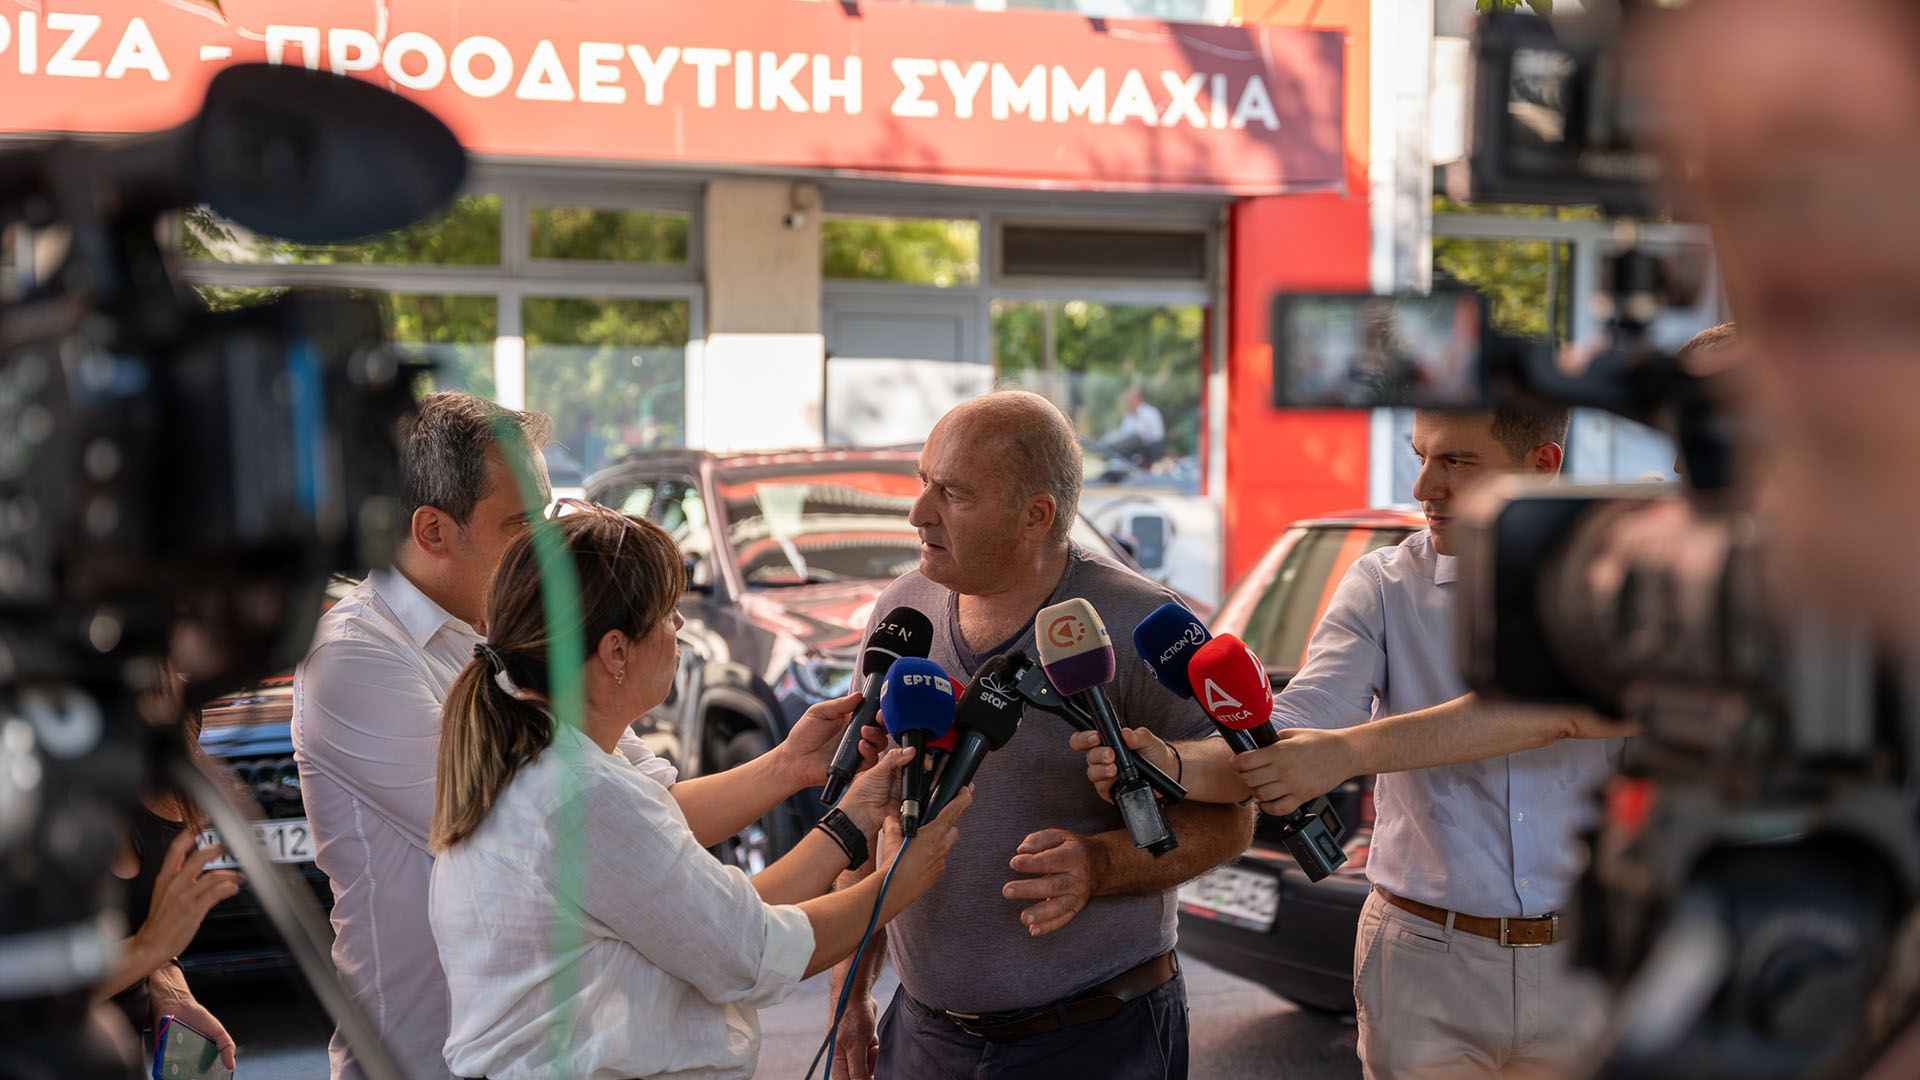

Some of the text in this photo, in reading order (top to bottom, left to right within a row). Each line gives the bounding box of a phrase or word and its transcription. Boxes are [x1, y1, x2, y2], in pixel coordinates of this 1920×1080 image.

[0, 11, 171, 81] ΙΖΑ
[265, 25, 862, 115] ΠΡΟΟΔΕΥΤΙΚΗ
[891, 58, 1280, 131] ΣΥΜΜΑΧΙΑ
[1160, 637, 1189, 664] ACTION
[903, 675, 931, 686] ΕΡΤ
[980, 692, 1007, 709] star
